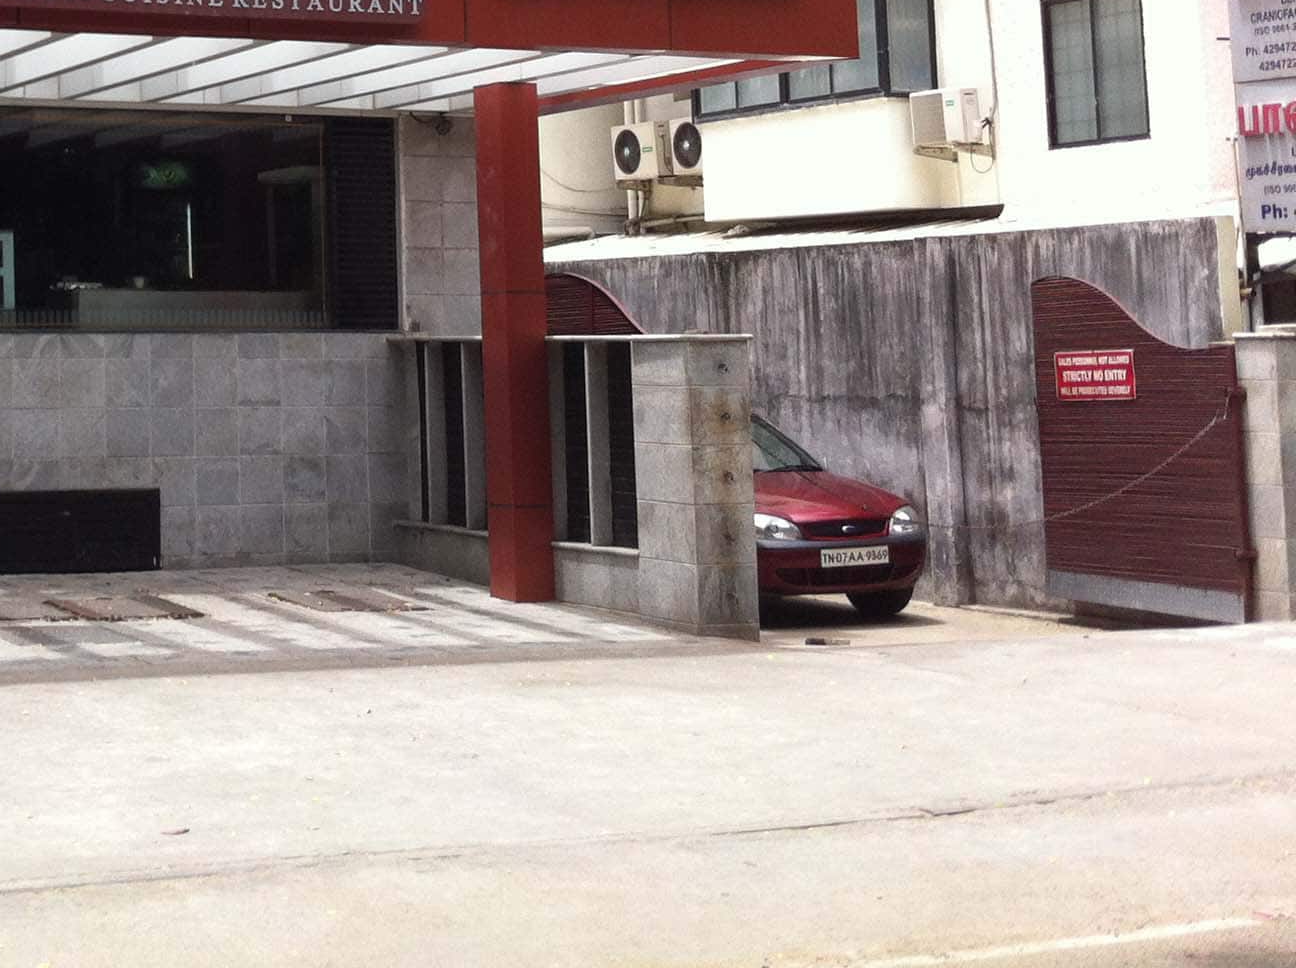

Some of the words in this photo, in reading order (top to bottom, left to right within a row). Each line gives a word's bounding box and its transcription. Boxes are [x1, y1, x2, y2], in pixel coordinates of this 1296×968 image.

[1261, 203, 1288, 219] Ph:
[1062, 370, 1092, 382] STRICTLY
[1093, 370, 1104, 381] NO
[1104, 369, 1127, 381] ENTRY
